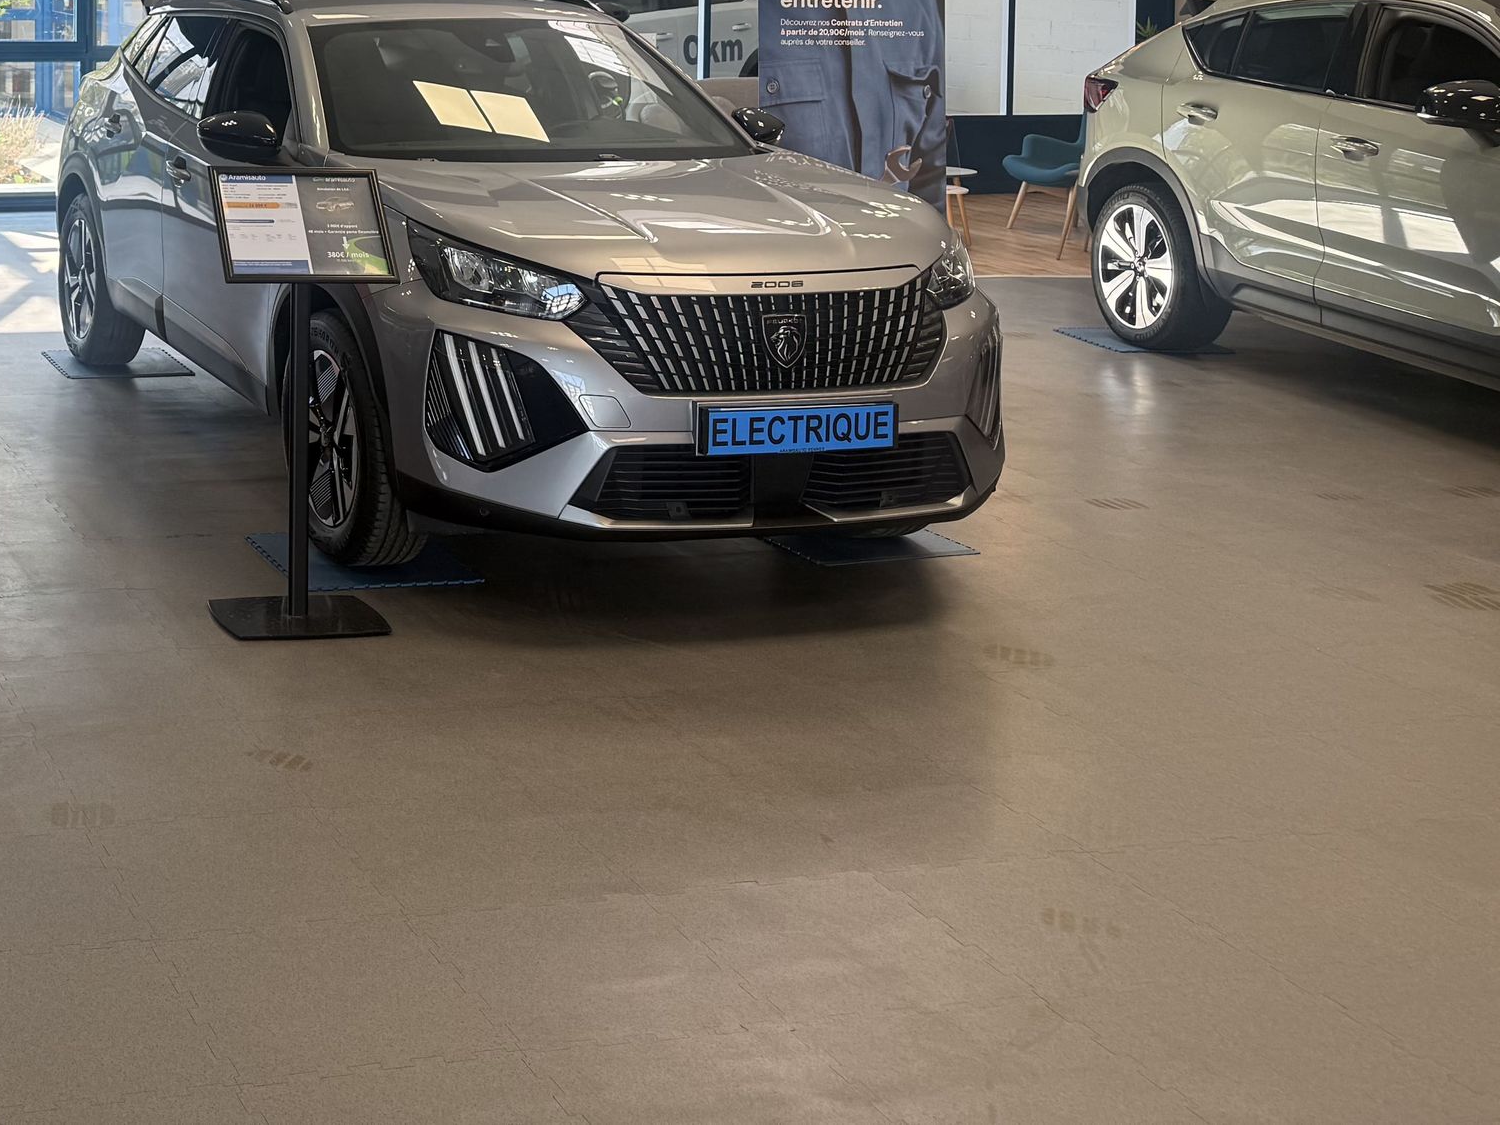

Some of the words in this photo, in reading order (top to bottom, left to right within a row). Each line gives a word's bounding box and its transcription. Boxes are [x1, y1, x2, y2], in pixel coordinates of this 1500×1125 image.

[780, 18, 817, 26] Découvrez
[863, 19, 903, 27] d'Entretien
[786, 29, 807, 37] partir
[868, 29, 925, 38] Renseignez-vous
[833, 38, 866, 46] conseiller.
[711, 411, 889, 447] ELECTRIQUE
